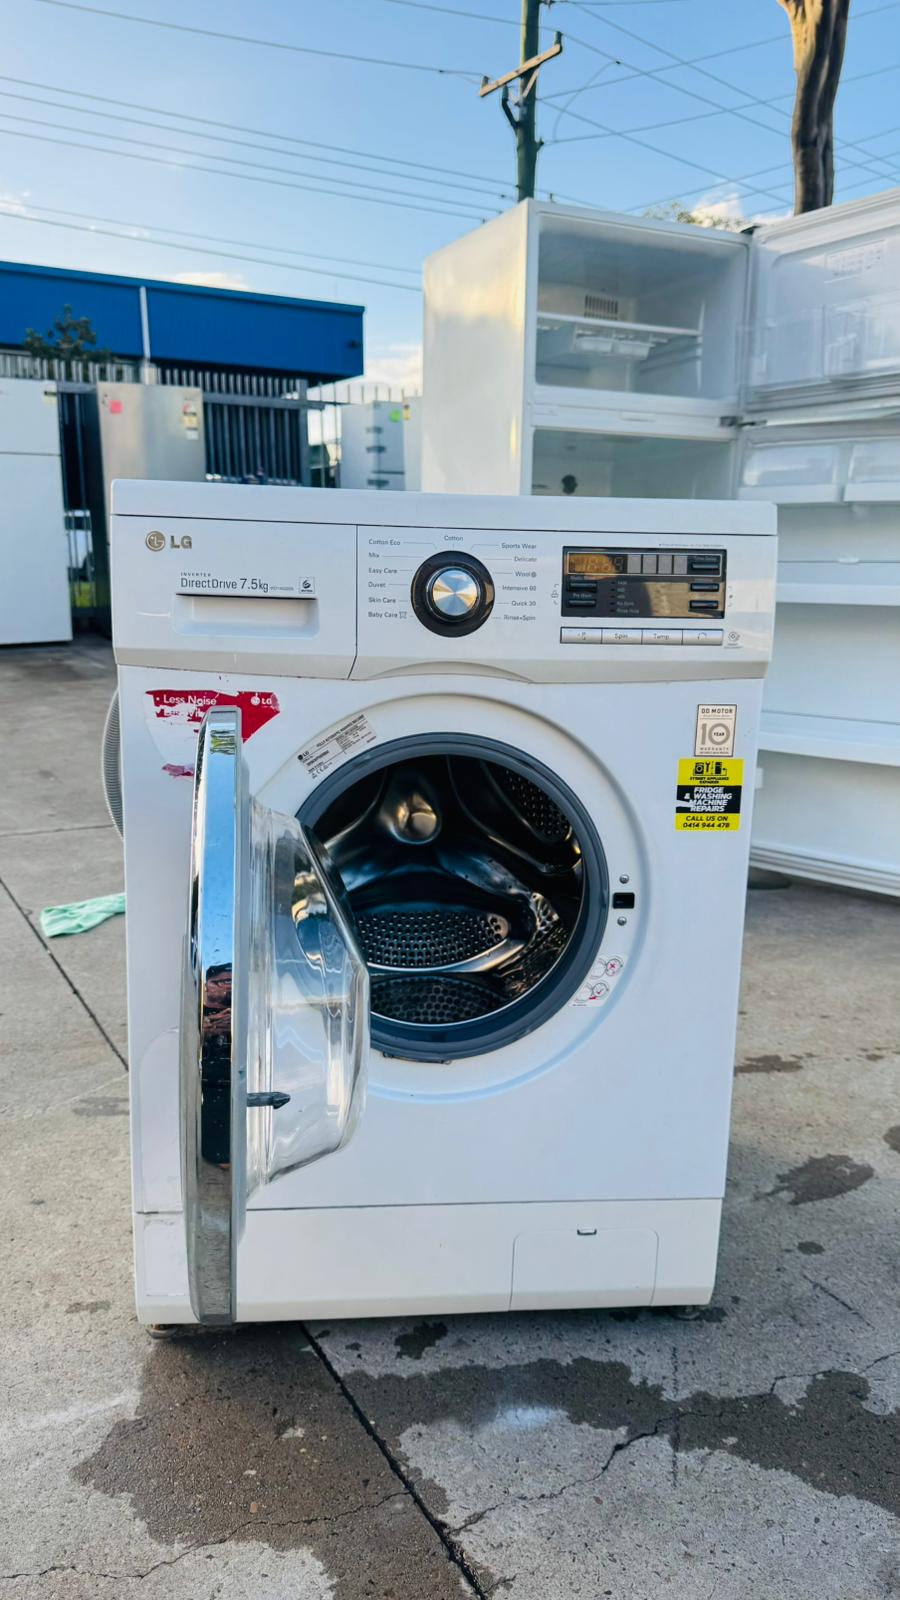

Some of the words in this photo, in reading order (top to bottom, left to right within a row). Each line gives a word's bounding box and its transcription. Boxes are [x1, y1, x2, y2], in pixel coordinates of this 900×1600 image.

[170, 535, 192, 549] LG
[239, 577, 269, 594] 7.5kg
[368, 611, 383, 619] Baby
[163, 694, 186, 704] Less
[188, 695, 217, 706] Noise
[700, 722, 731, 746] 10
